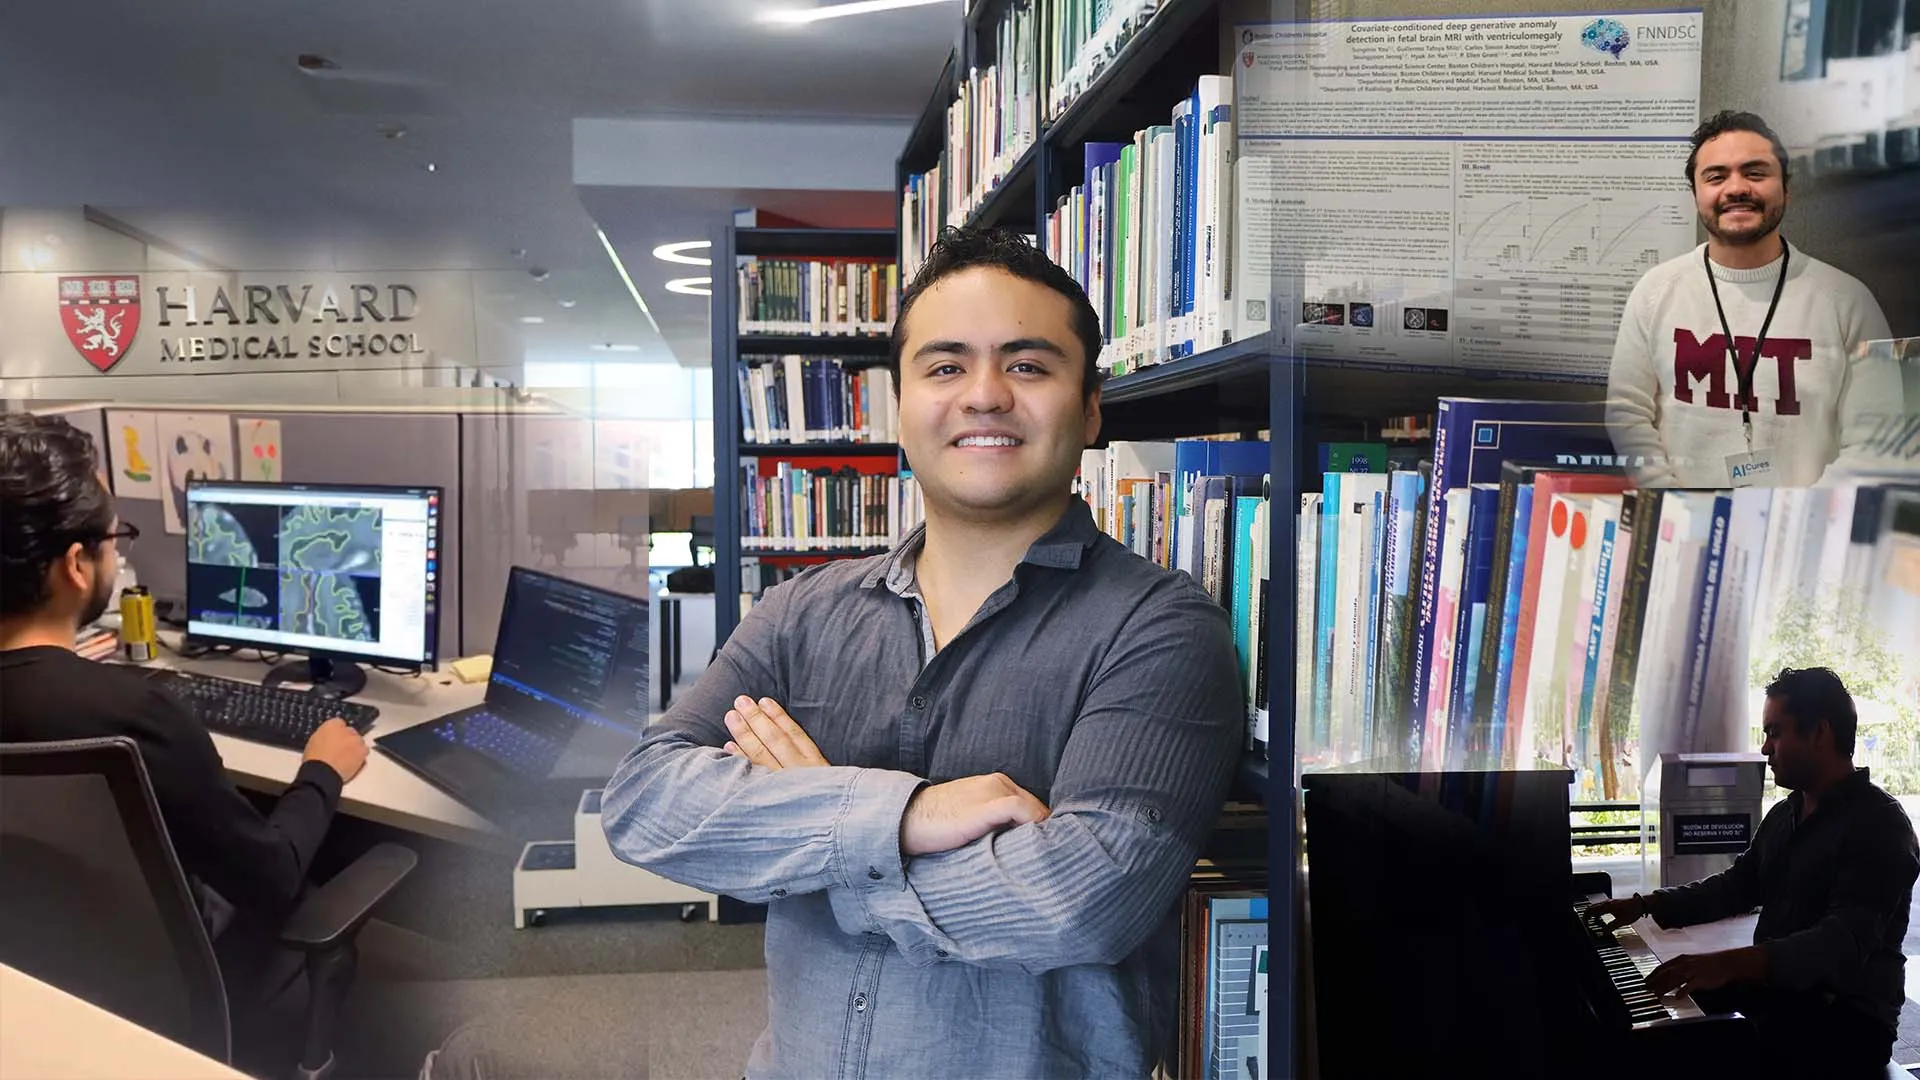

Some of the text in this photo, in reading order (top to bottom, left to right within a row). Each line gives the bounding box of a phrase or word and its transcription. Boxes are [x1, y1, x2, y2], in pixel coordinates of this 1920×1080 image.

[1346, 31, 1563, 44] detection in fetal brain MRI with ventriculomegaly
[1351, 20, 1557, 32] Covariate-conditioned deep generative anomaly
[1636, 25, 1697, 39] FNNDSC
[157, 284, 421, 326] HARVARD
[160, 332, 425, 363] MEDICAL SCHOOL
[1673, 328, 1812, 415] MIT
[1745, 461, 1770, 471] Cures
[1425, 428, 1446, 623] DEMAND FORECASTING
[1711, 515, 1726, 556] SIGLO
[1708, 557, 1720, 585] DEL
[1386, 593, 1394, 624] LAND
[1420, 560, 1432, 630] UTILITY
[1588, 540, 1613, 660] Planning Law
[1699, 585, 1716, 640] AGRARIA
[1413, 634, 1425, 708] INDUSTRY
